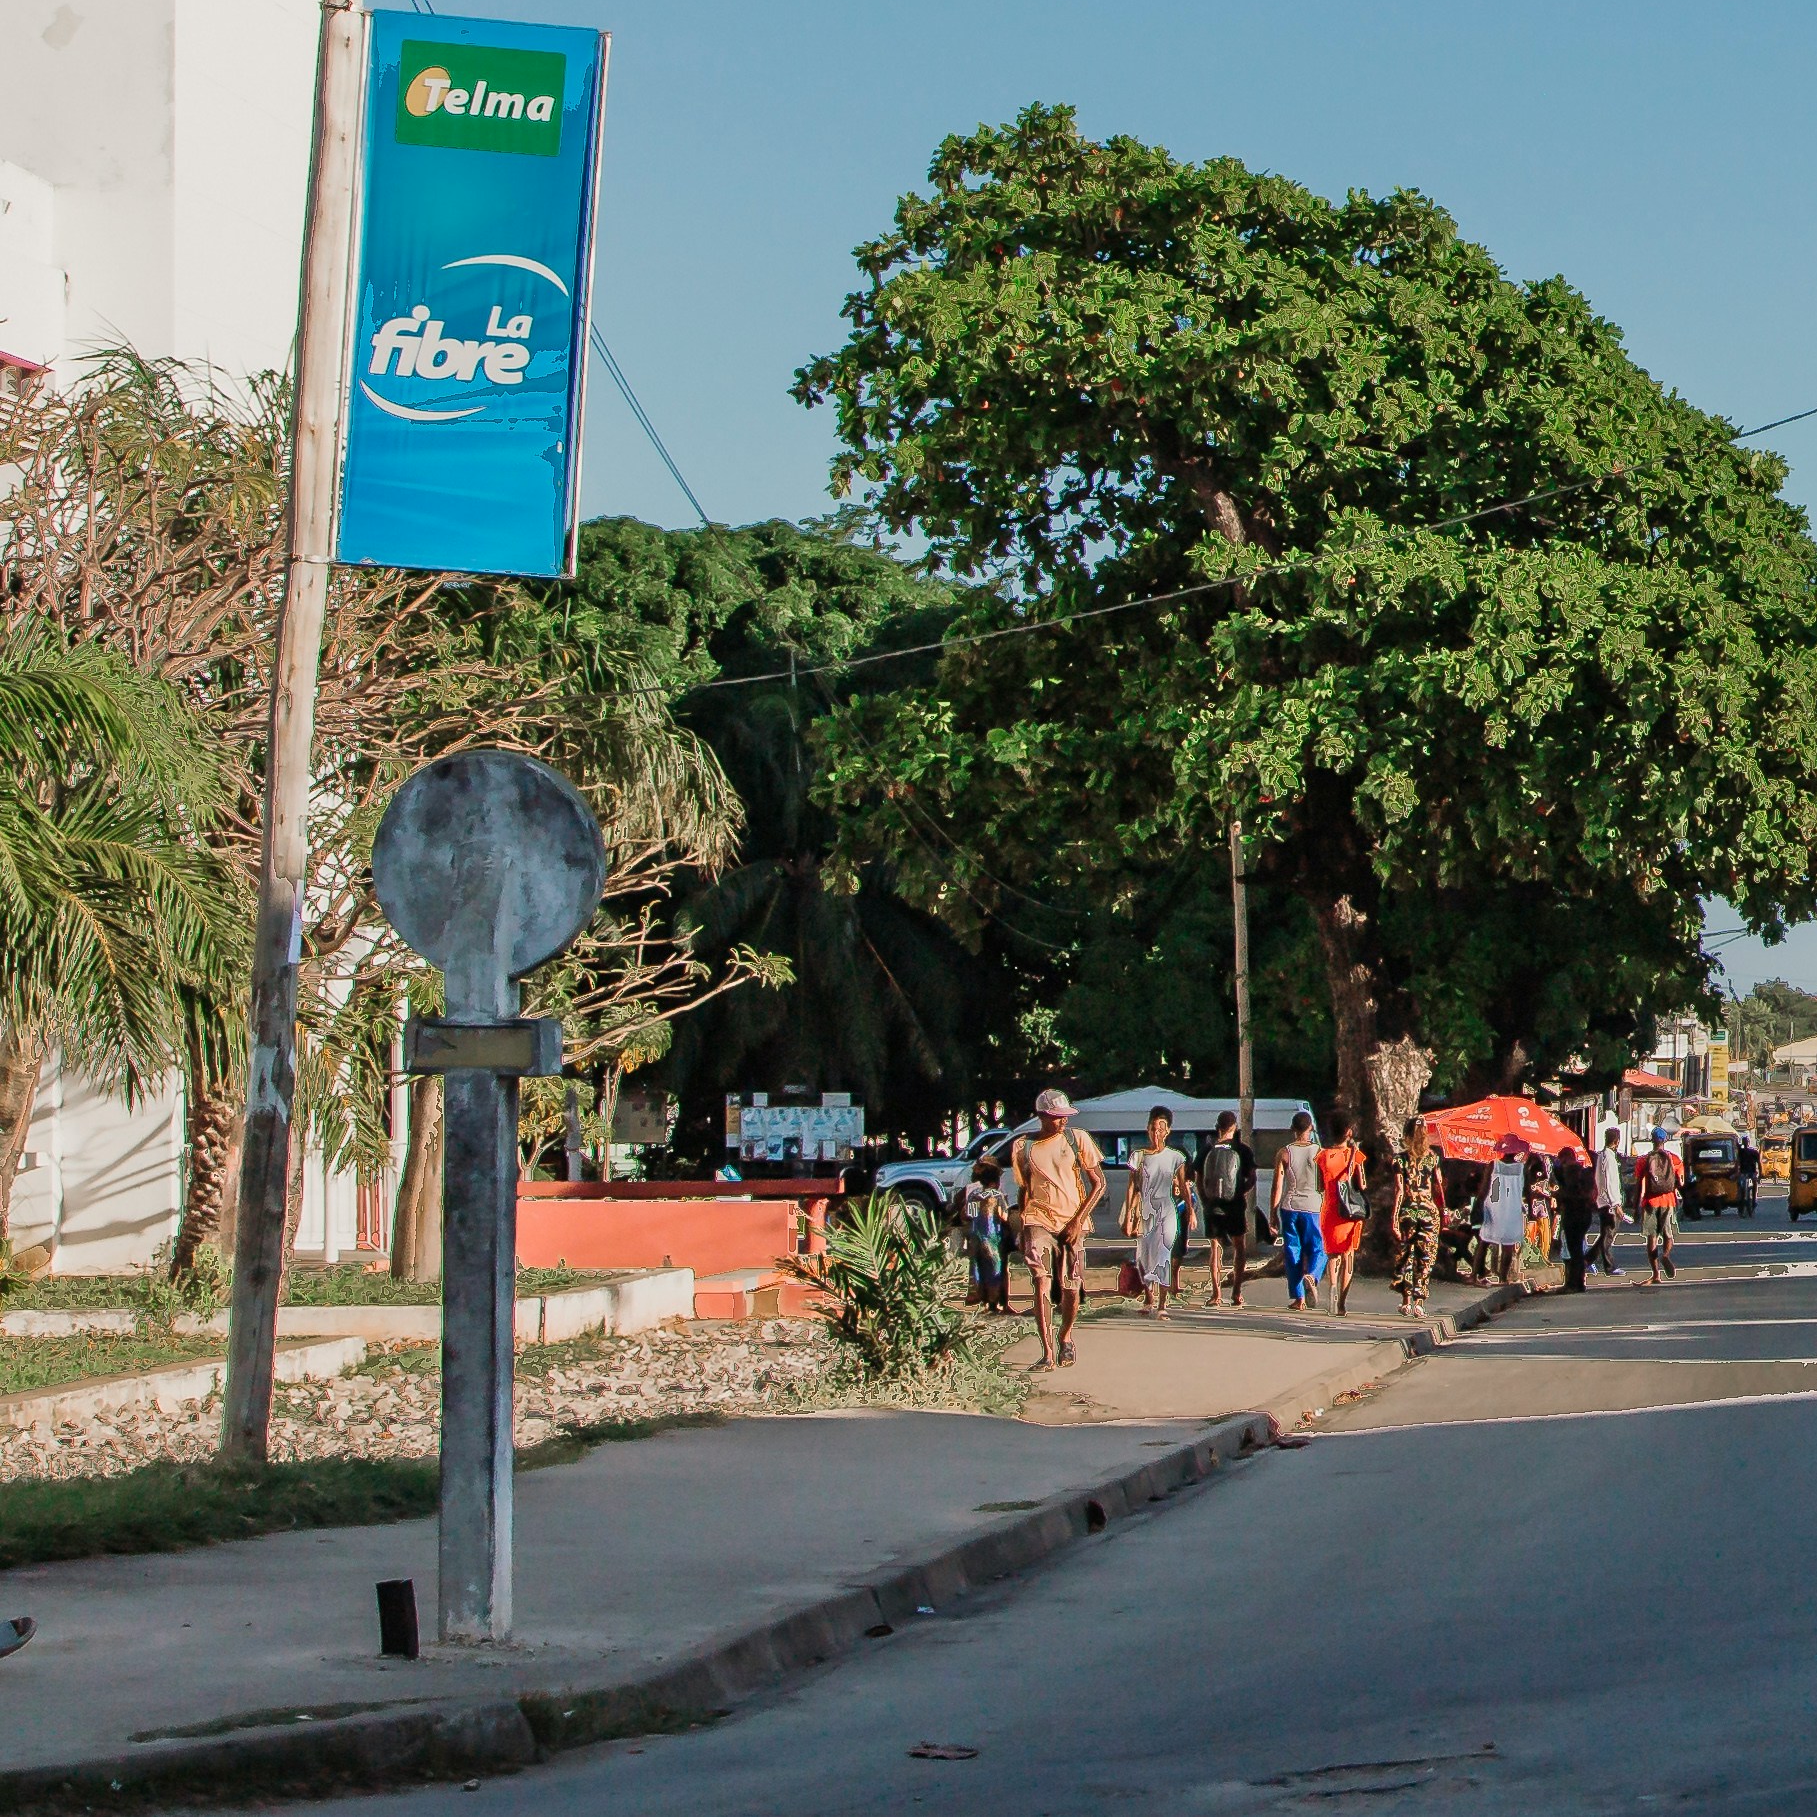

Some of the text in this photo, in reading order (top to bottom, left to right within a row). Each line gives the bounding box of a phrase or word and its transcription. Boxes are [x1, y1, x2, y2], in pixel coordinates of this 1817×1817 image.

[423, 78, 555, 123] Telma
[369, 305, 531, 384] fibre
[487, 306, 533, 340] La
